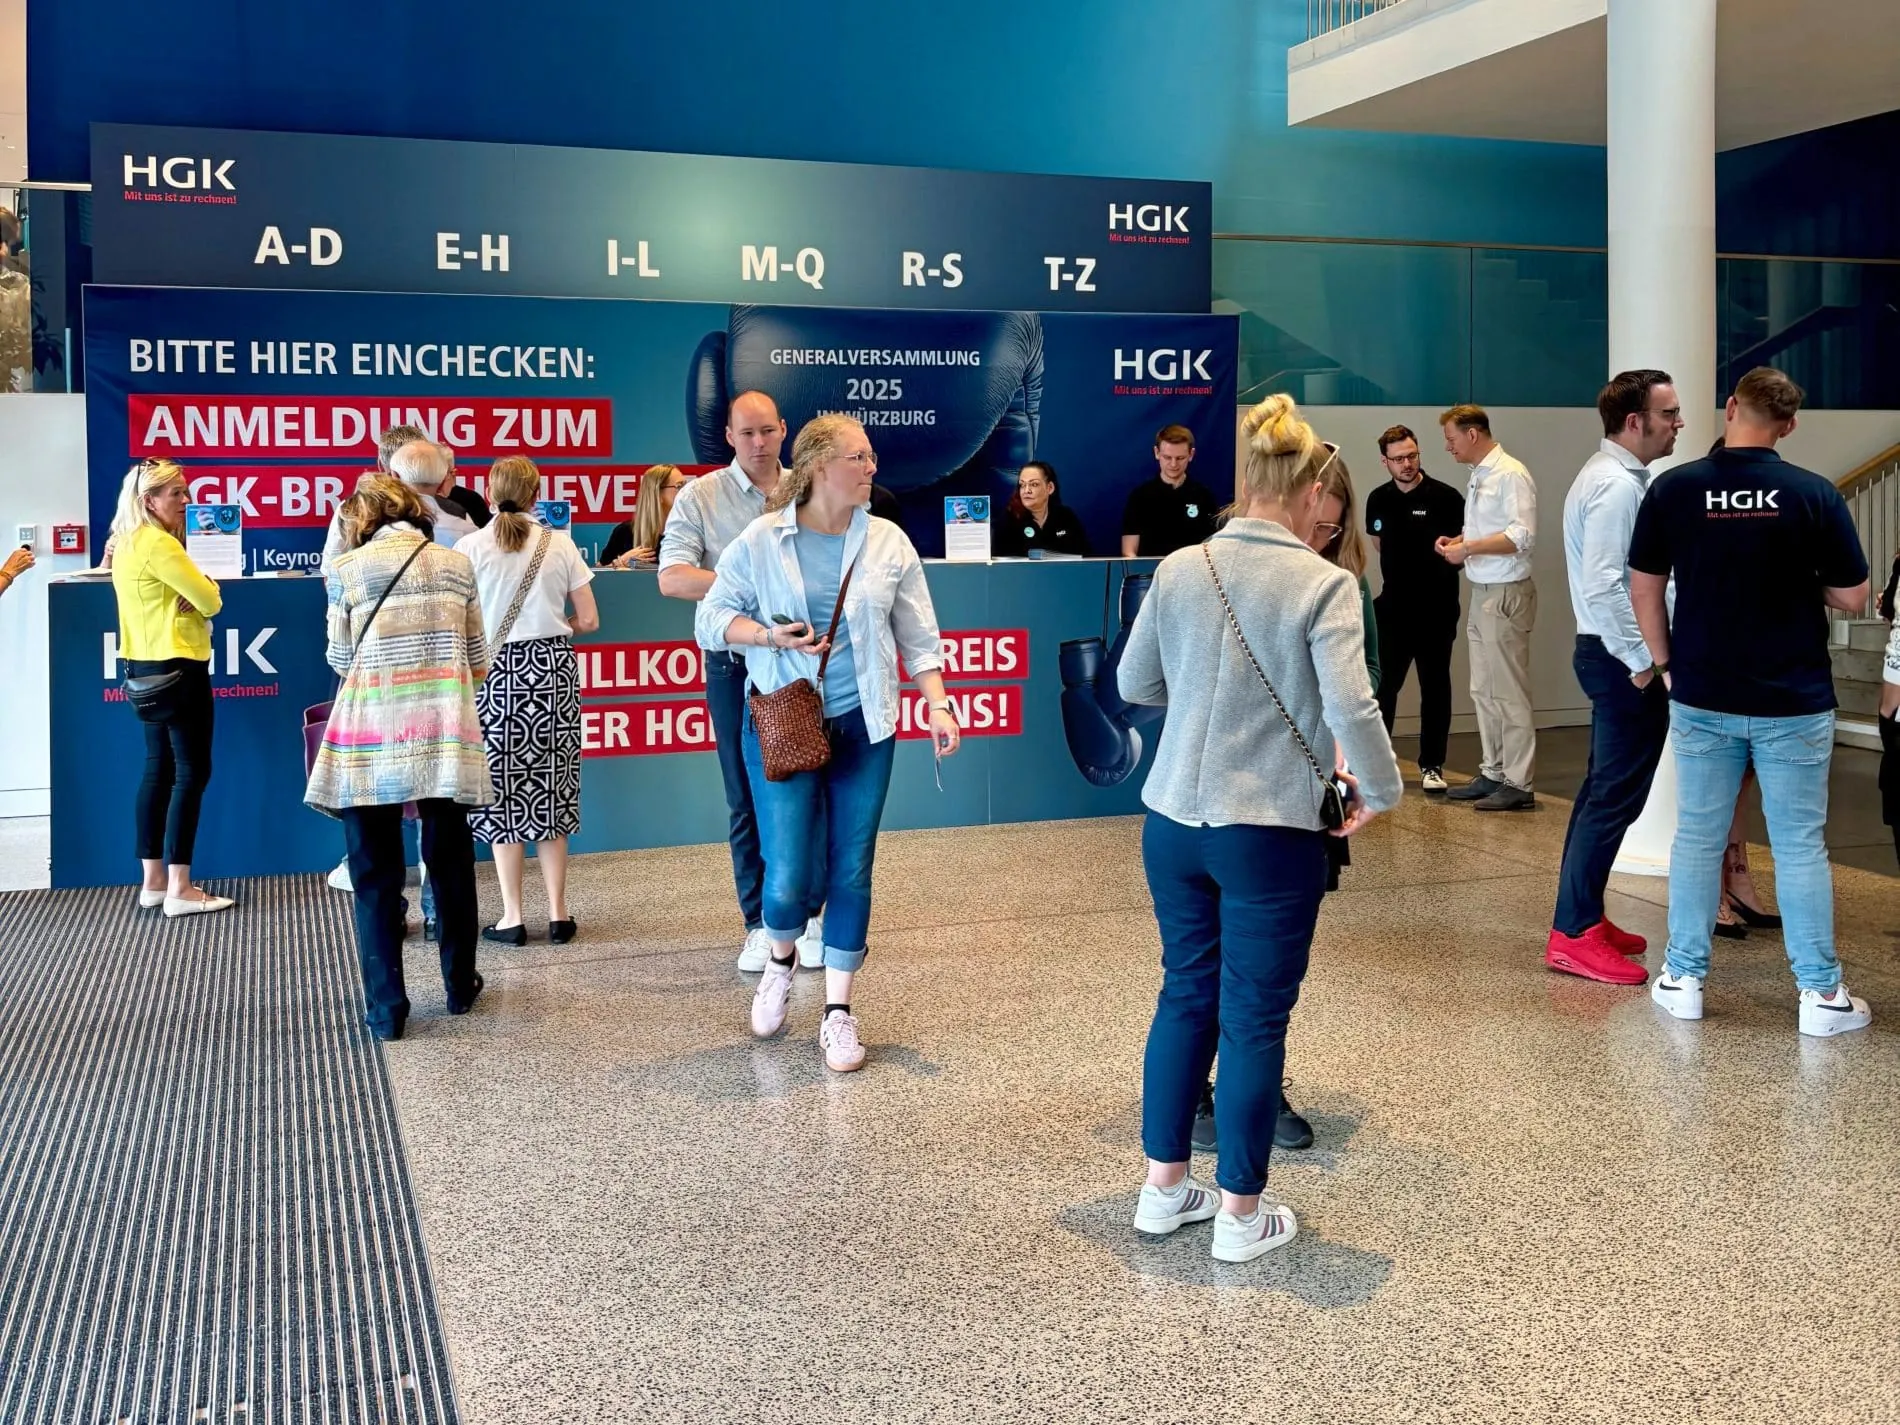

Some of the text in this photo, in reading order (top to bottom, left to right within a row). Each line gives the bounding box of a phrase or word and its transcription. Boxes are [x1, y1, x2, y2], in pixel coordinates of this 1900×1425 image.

[123, 154, 237, 190] HGK
[124, 190, 237, 205] Mit uns ist zu rechnen!
[1109, 203, 1190, 232] HGK
[254, 225, 343, 266] A-D
[436, 232, 509, 272] E-H
[1109, 233, 1122, 242] Mit
[1123, 235, 1137, 243] uns
[1138, 235, 1148, 243] ist
[1158, 236, 1190, 245] rechnen!
[607, 239, 660, 278] I-L
[741, 244, 825, 290] M-Q
[902, 251, 964, 288] R-S
[1043, 256, 1097, 292] T-Z
[129, 338, 595, 379] BITTE HIER EINCHECKEN:
[770, 349, 980, 366] GENERALVERSAMMLUNG
[1114, 348, 1213, 381] HGK
[846, 378, 903, 401] 2025
[1131, 387, 1147, 395] uns
[1148, 386, 1160, 395] ist
[1162, 387, 1173, 395] zu
[1174, 386, 1212, 395] rechnen!
[492, 408, 597, 448] ZUM
[1705, 489, 1780, 510] HGK
[939, 635, 1018, 673] REIS
[211, 682, 279, 698] rechnen!
